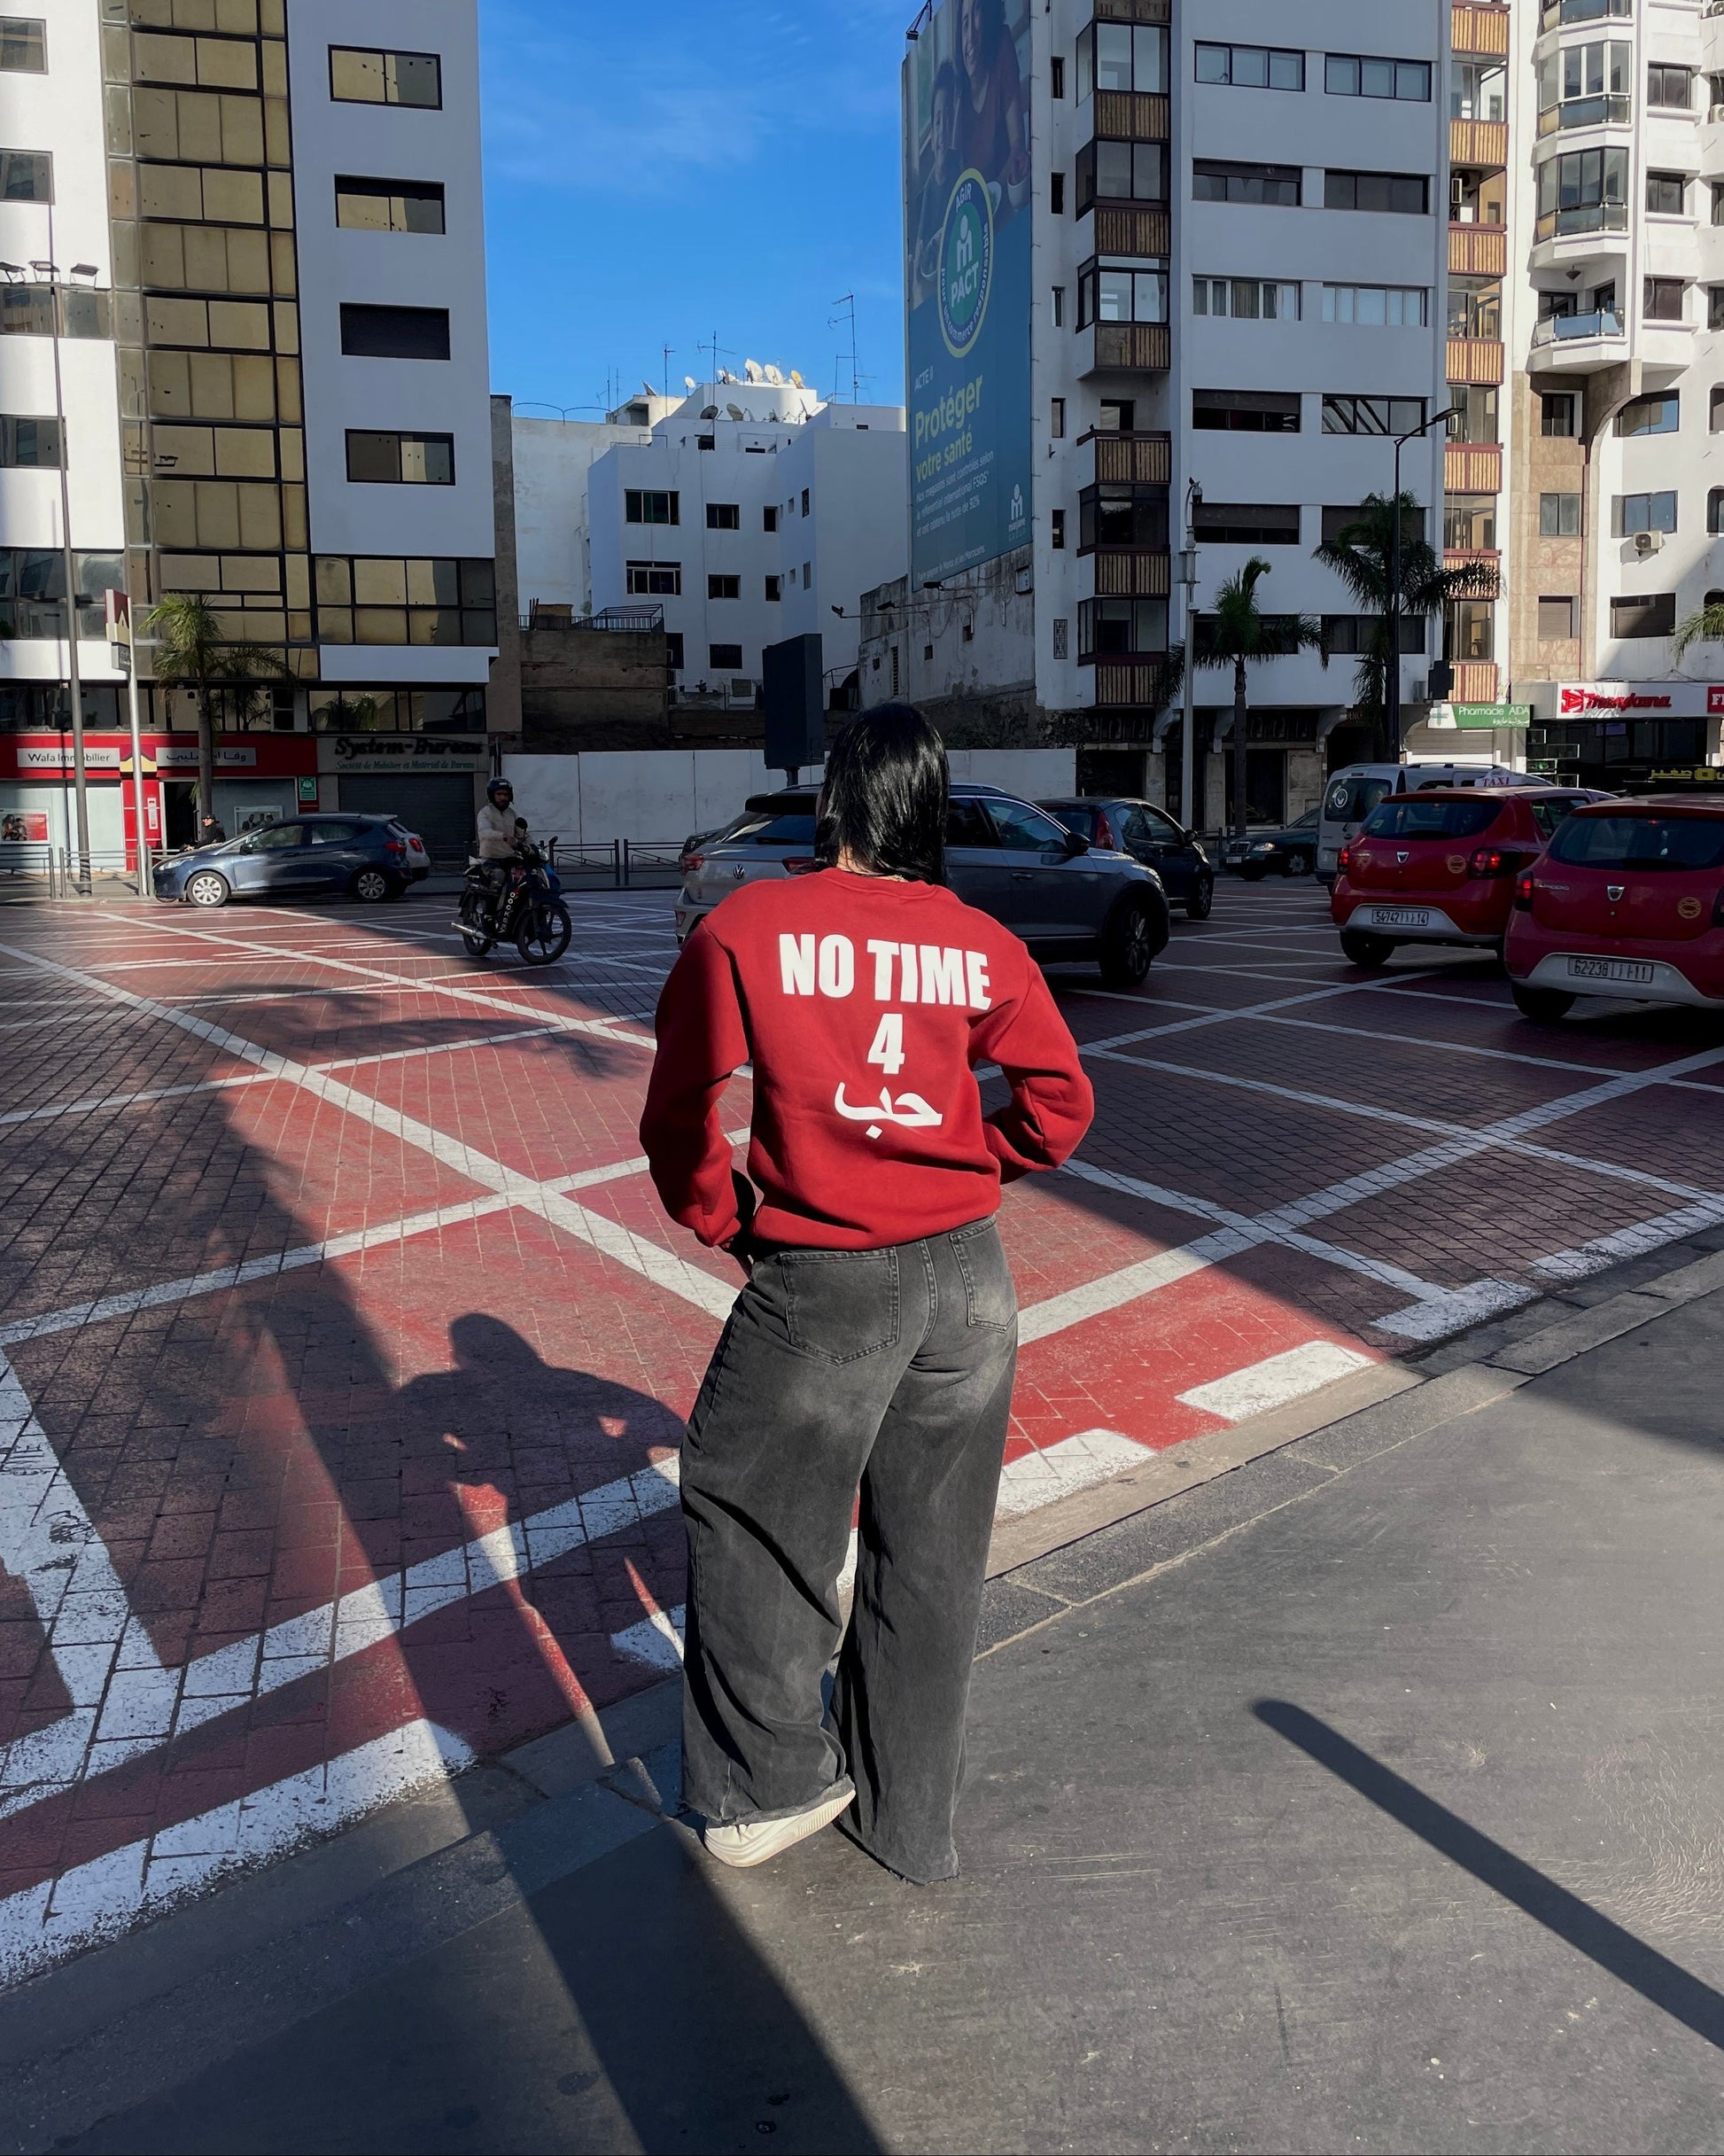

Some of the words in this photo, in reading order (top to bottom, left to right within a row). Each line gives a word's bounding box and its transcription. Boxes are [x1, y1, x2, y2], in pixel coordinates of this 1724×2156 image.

[955, 183, 972, 214] AGIR
[948, 321, 974, 342] commerce
[974, 222, 990, 323] responsable
[951, 261, 979, 308] PACT
[914, 368, 929, 393] ACTE
[915, 374, 983, 449] Protéger
[916, 452, 942, 483] votre
[944, 424, 973, 466] santé
[979, 450, 994, 467] selon
[944, 479, 973, 506] international
[1458, 705, 1504, 715] Pharmacie
[1508, 705, 1530, 715] AIDA
[336, 760, 361, 769] Société
[1482, 777, 1510, 787] TAXI
[780, 934, 855, 998] NO
[866, 939, 992, 1010] TIME
[867, 1013, 905, 1075] 4
[835, 1082, 943, 1140] حب
